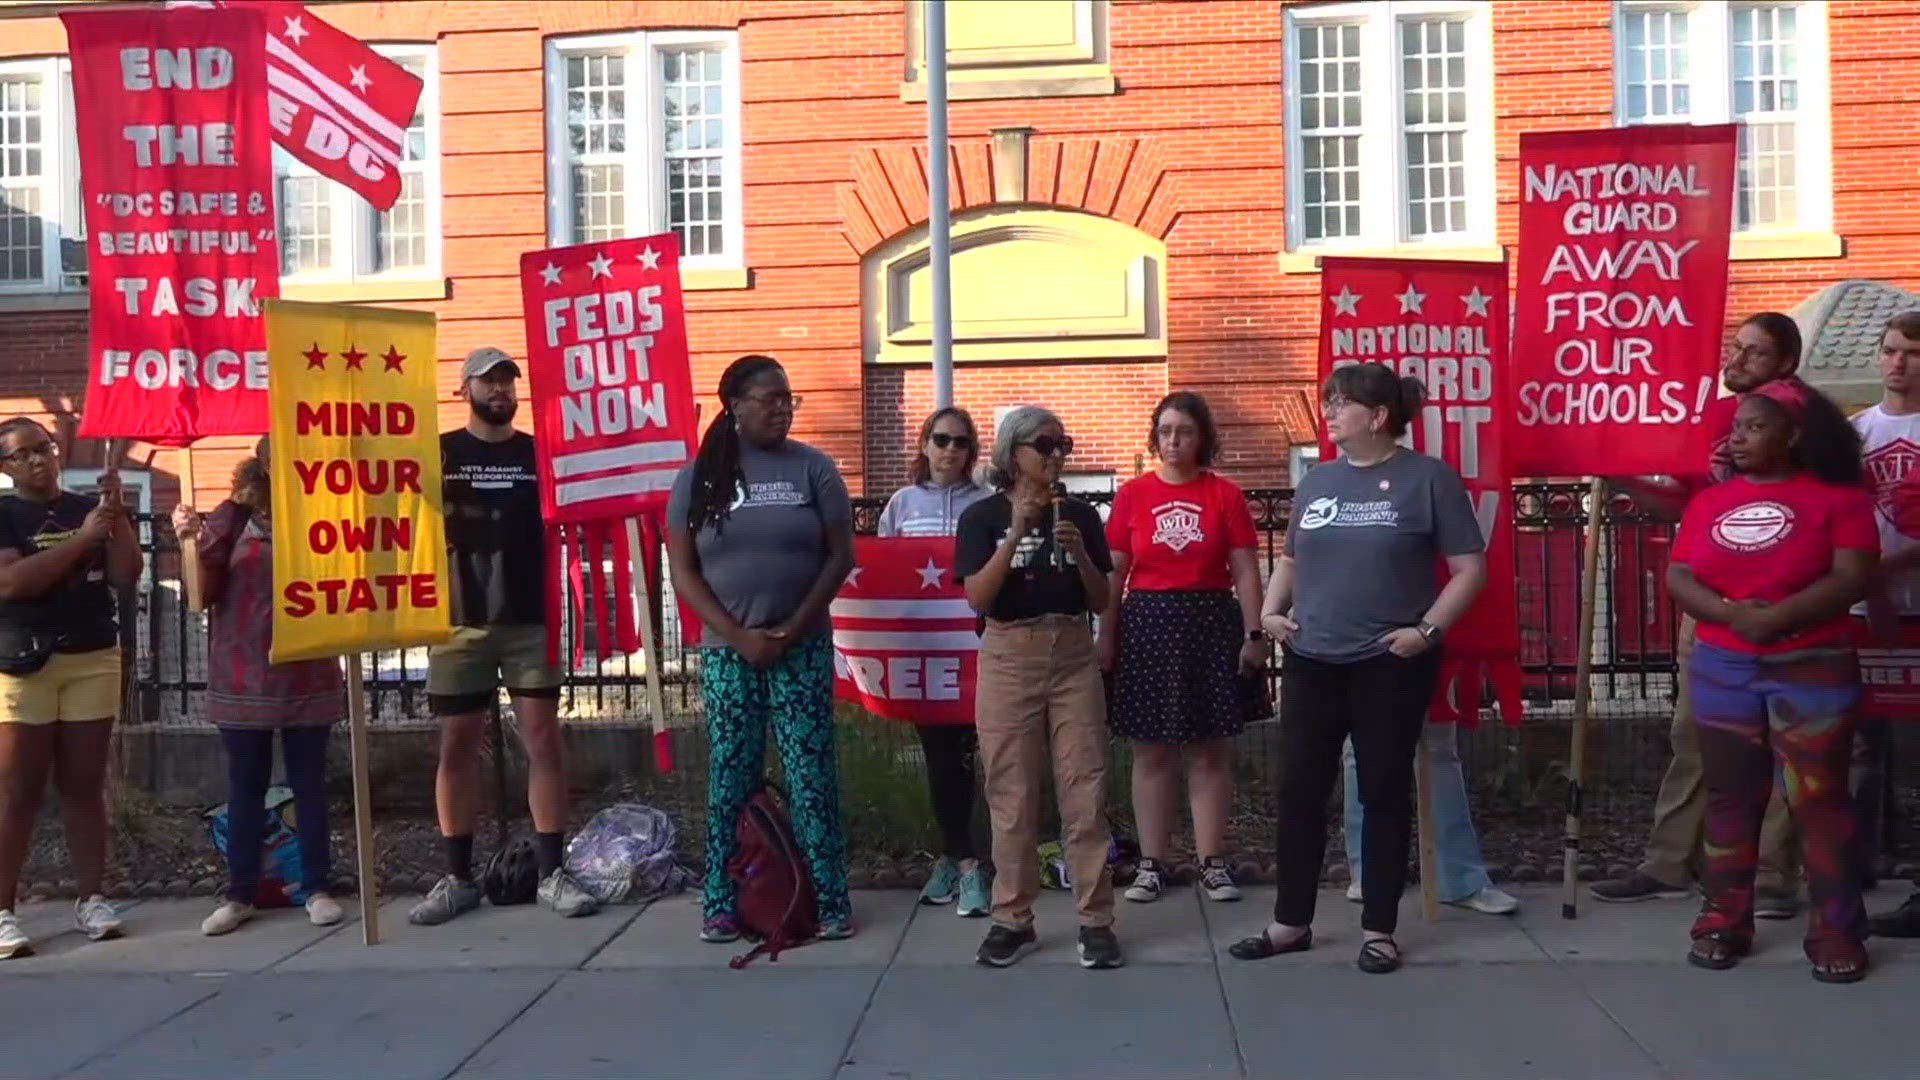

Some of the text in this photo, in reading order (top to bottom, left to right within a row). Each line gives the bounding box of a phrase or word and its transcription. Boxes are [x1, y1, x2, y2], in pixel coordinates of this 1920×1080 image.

[119, 47, 233, 91] END
[124, 122, 235, 167] THE
[305, 113, 385, 182] DC
[159, 190, 237, 215] SAFE
[247, 191, 266, 215] &
[1525, 163, 1709, 202] NATIONAL
[1563, 201, 1677, 235] GUARD
[98, 229, 273, 255] BEAUTIFUL"
[1540, 240, 1699, 285] AWAY
[115, 277, 259, 317] TASK
[544, 285, 663, 347] FEDS
[1544, 291, 1693, 333] FROM
[1332, 324, 1491, 356] NATIONAL
[1554, 337, 1660, 377] OUR
[101, 349, 269, 390] FORCE
[564, 335, 654, 392] OUT
[297, 402, 415, 436] MIND
[560, 383, 667, 440] NOW
[1517, 375, 1713, 426] SCHOOLS!
[294, 459, 422, 496] YOUR
[309, 516, 411, 554] OWN
[284, 574, 438, 617] STATE
